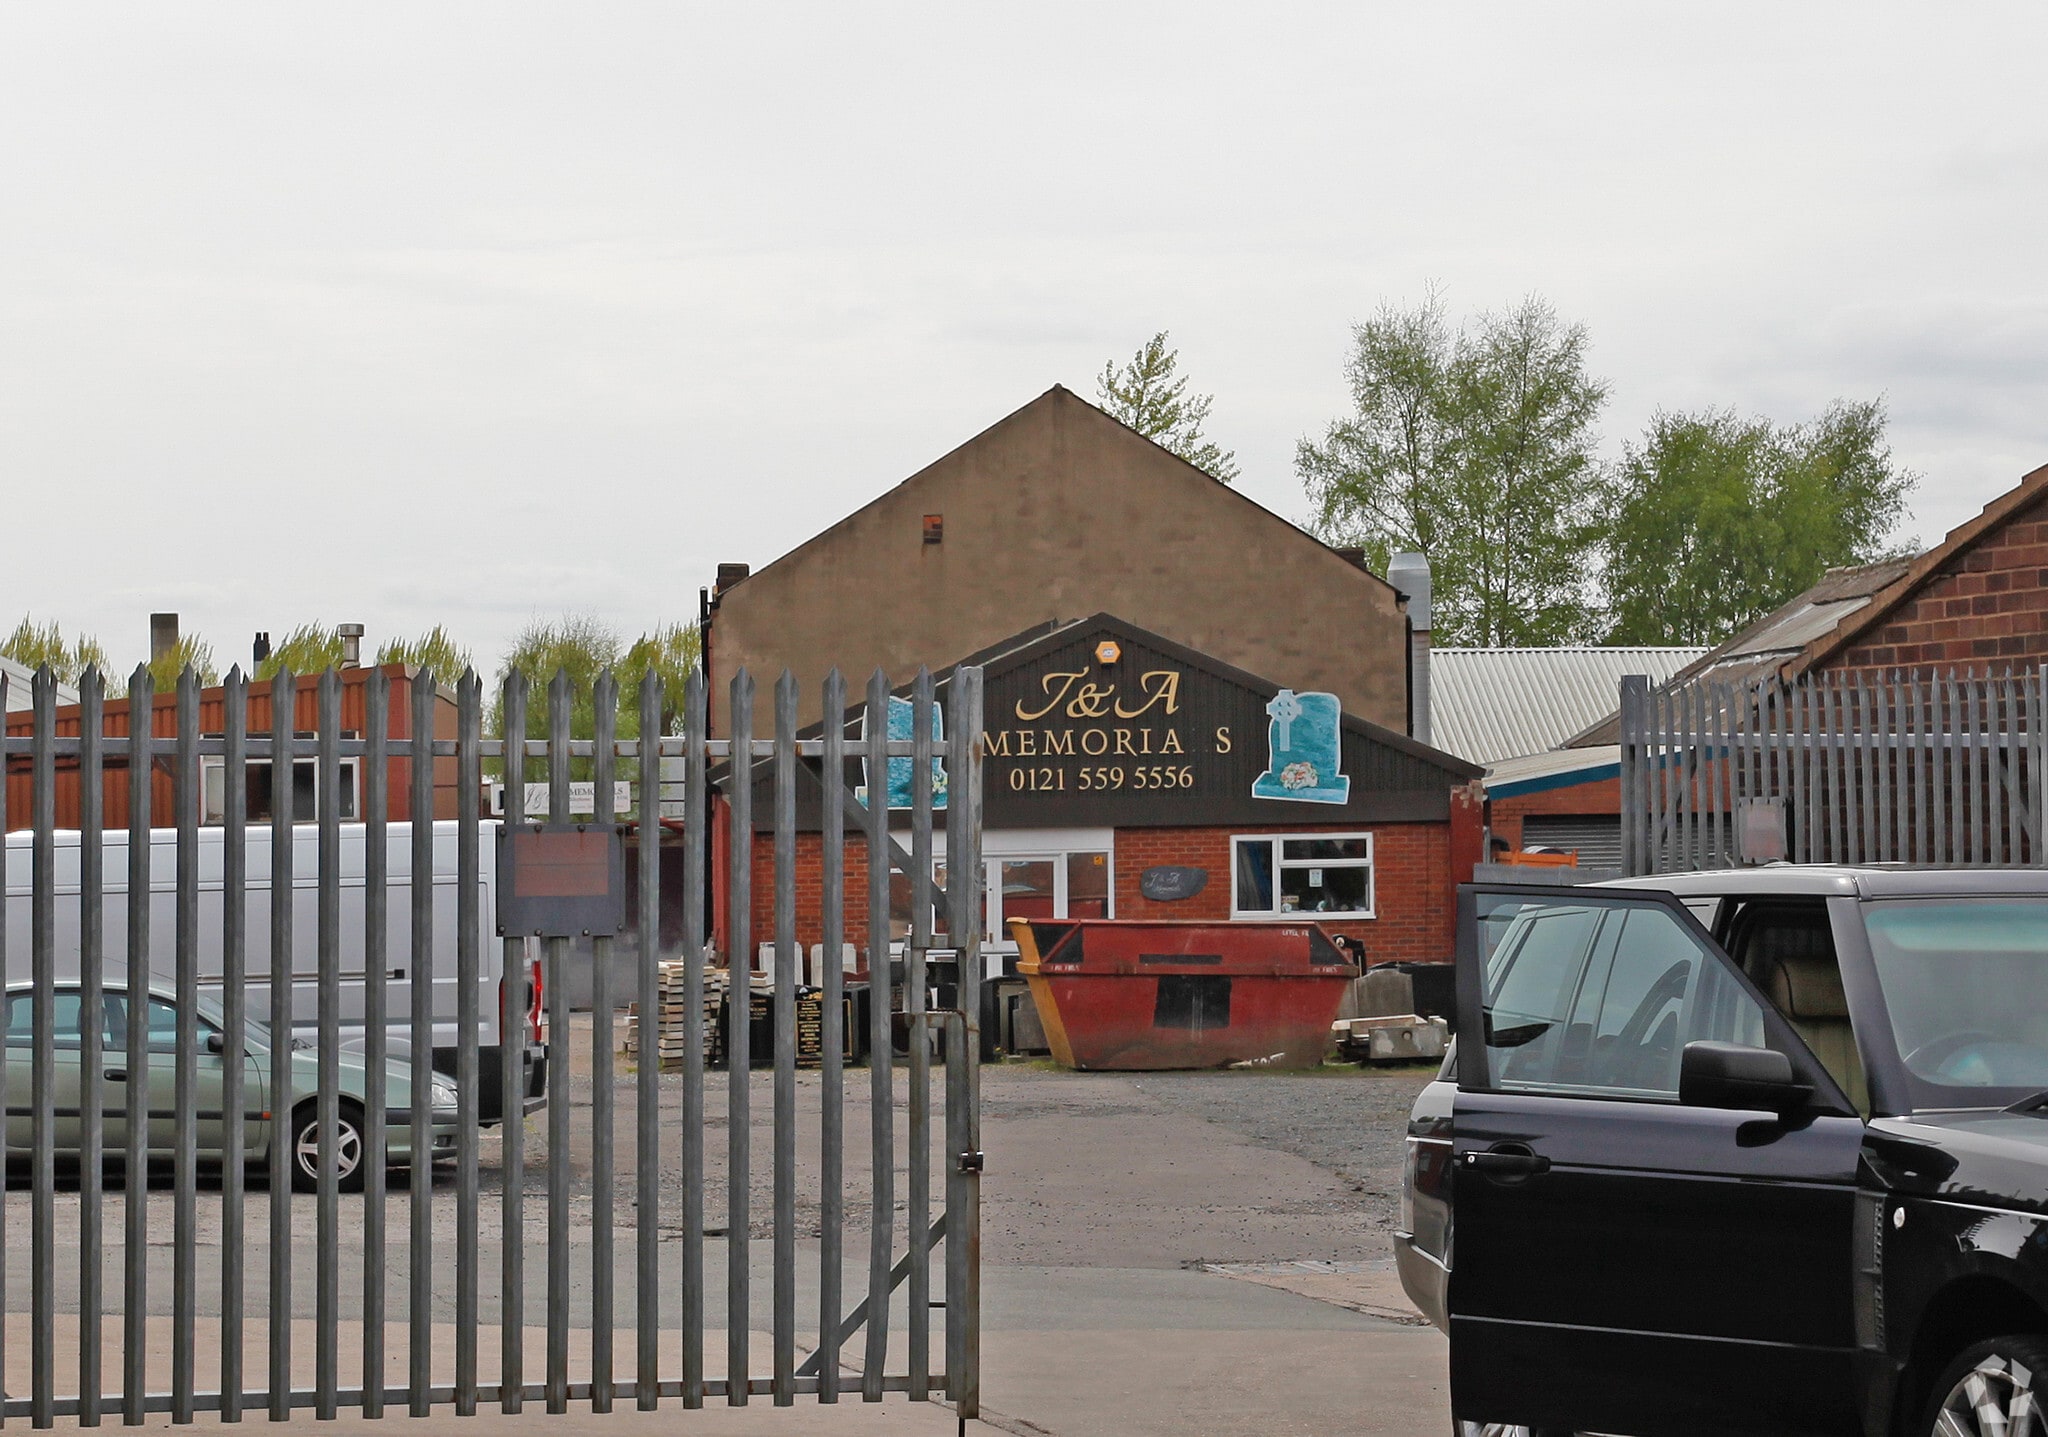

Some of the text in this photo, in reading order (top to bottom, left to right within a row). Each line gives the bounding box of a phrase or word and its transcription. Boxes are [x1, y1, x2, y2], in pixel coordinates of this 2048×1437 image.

[1009, 765, 1194, 791] 0121 559 5556
